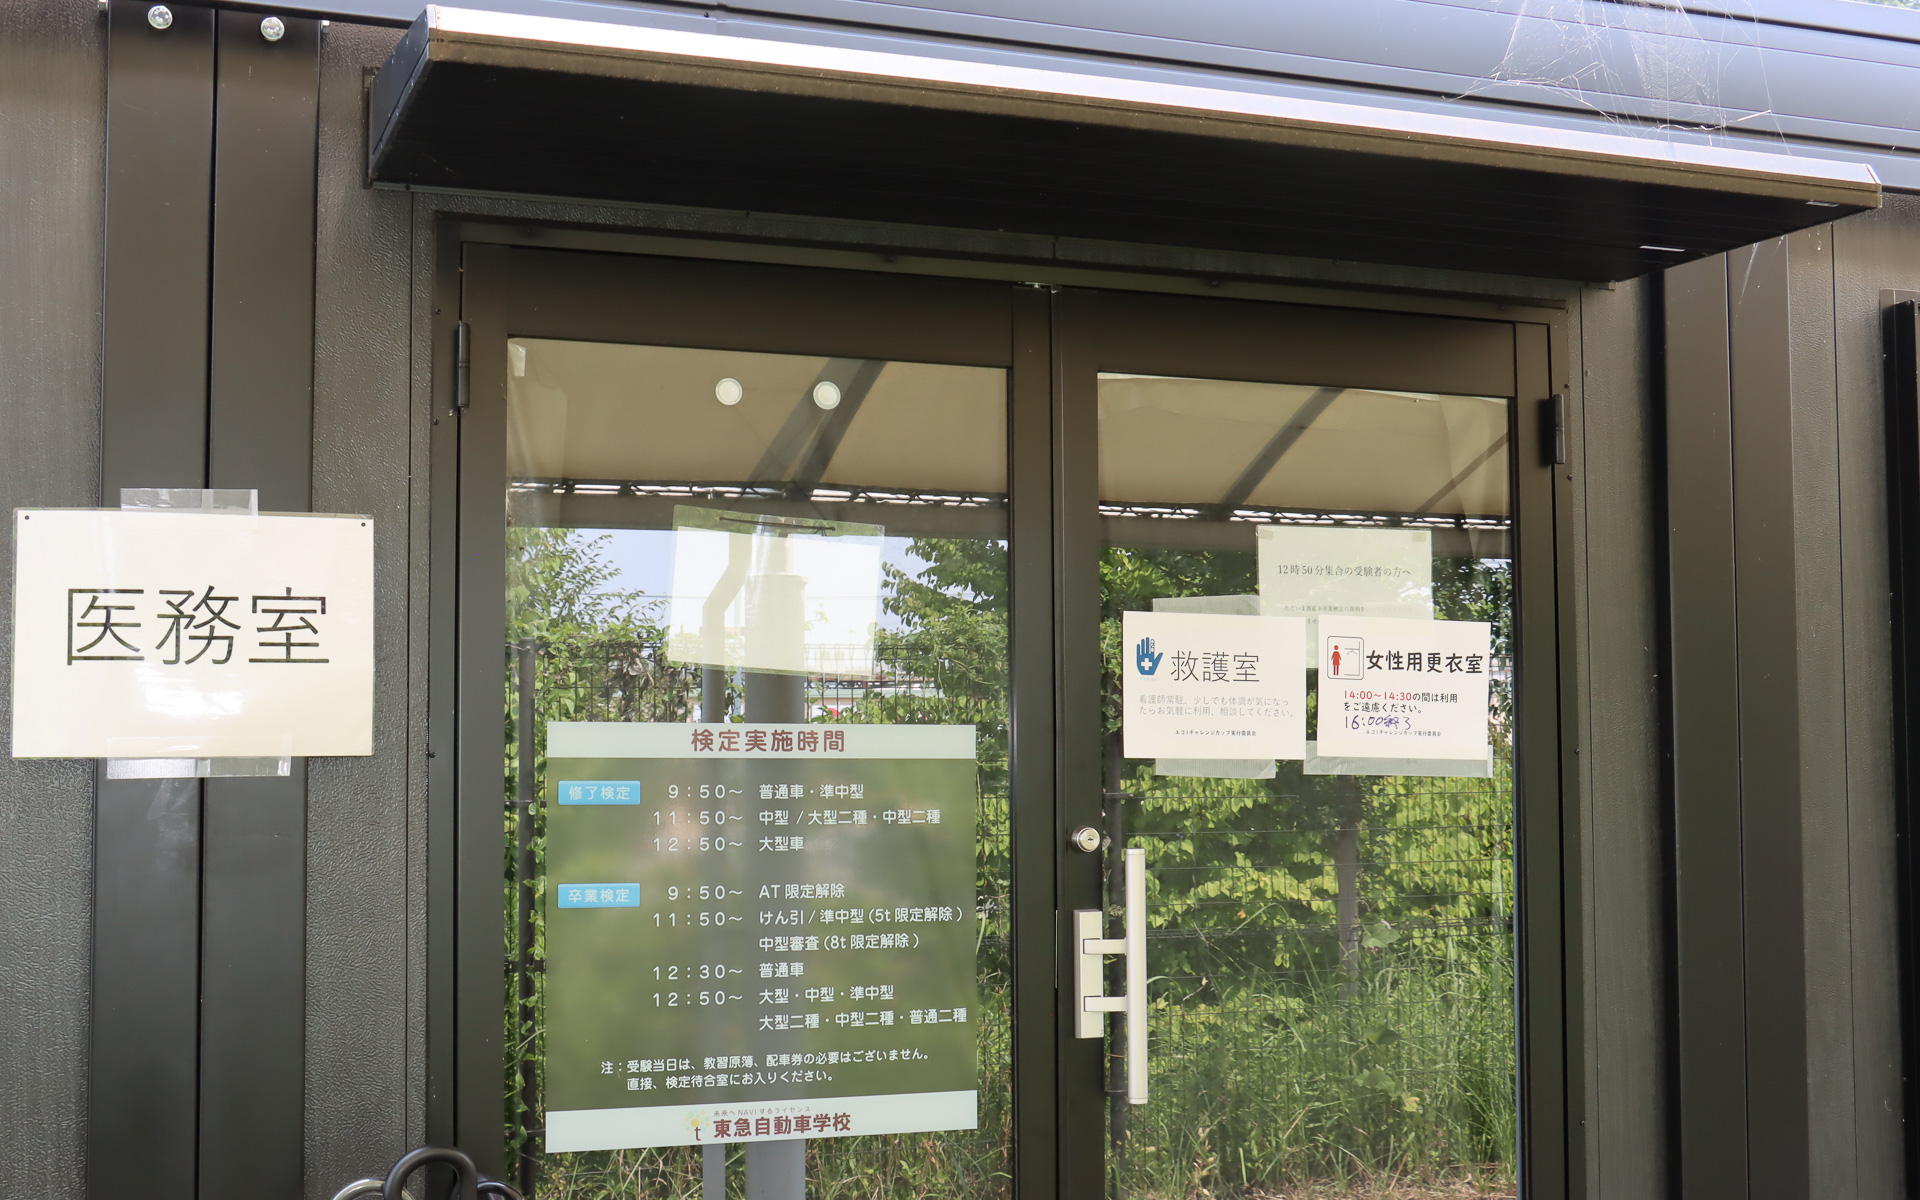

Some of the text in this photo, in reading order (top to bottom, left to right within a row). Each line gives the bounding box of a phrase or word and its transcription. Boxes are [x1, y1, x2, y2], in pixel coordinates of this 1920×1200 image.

[1277, 564, 1412, 578] 12時50分集合の受験者の方へ
[67, 585, 330, 666] 医務室
[1170, 650, 1260, 683] 救護室
[1366, 649, 1483, 674] 女性用更衣室
[1344, 702, 1422, 714] をご遠慮ください。
[691, 729, 846, 754] 検定実施時間
[568, 785, 631, 800] 修了検定
[758, 783, 865, 800] 普通車・準中型
[758, 835, 805, 852] 大型車
[567, 888, 630, 903] 卒業検定
[758, 961, 805, 979] 普通車
[758, 984, 894, 1005] 大型・中型・準中型
[758, 1007, 968, 1031] 大型二種・中型二種・普通二種
[626, 1069, 834, 1091] 直接、検定待合室にお入りください。
[712, 1112, 851, 1139] 東急自動車学校
